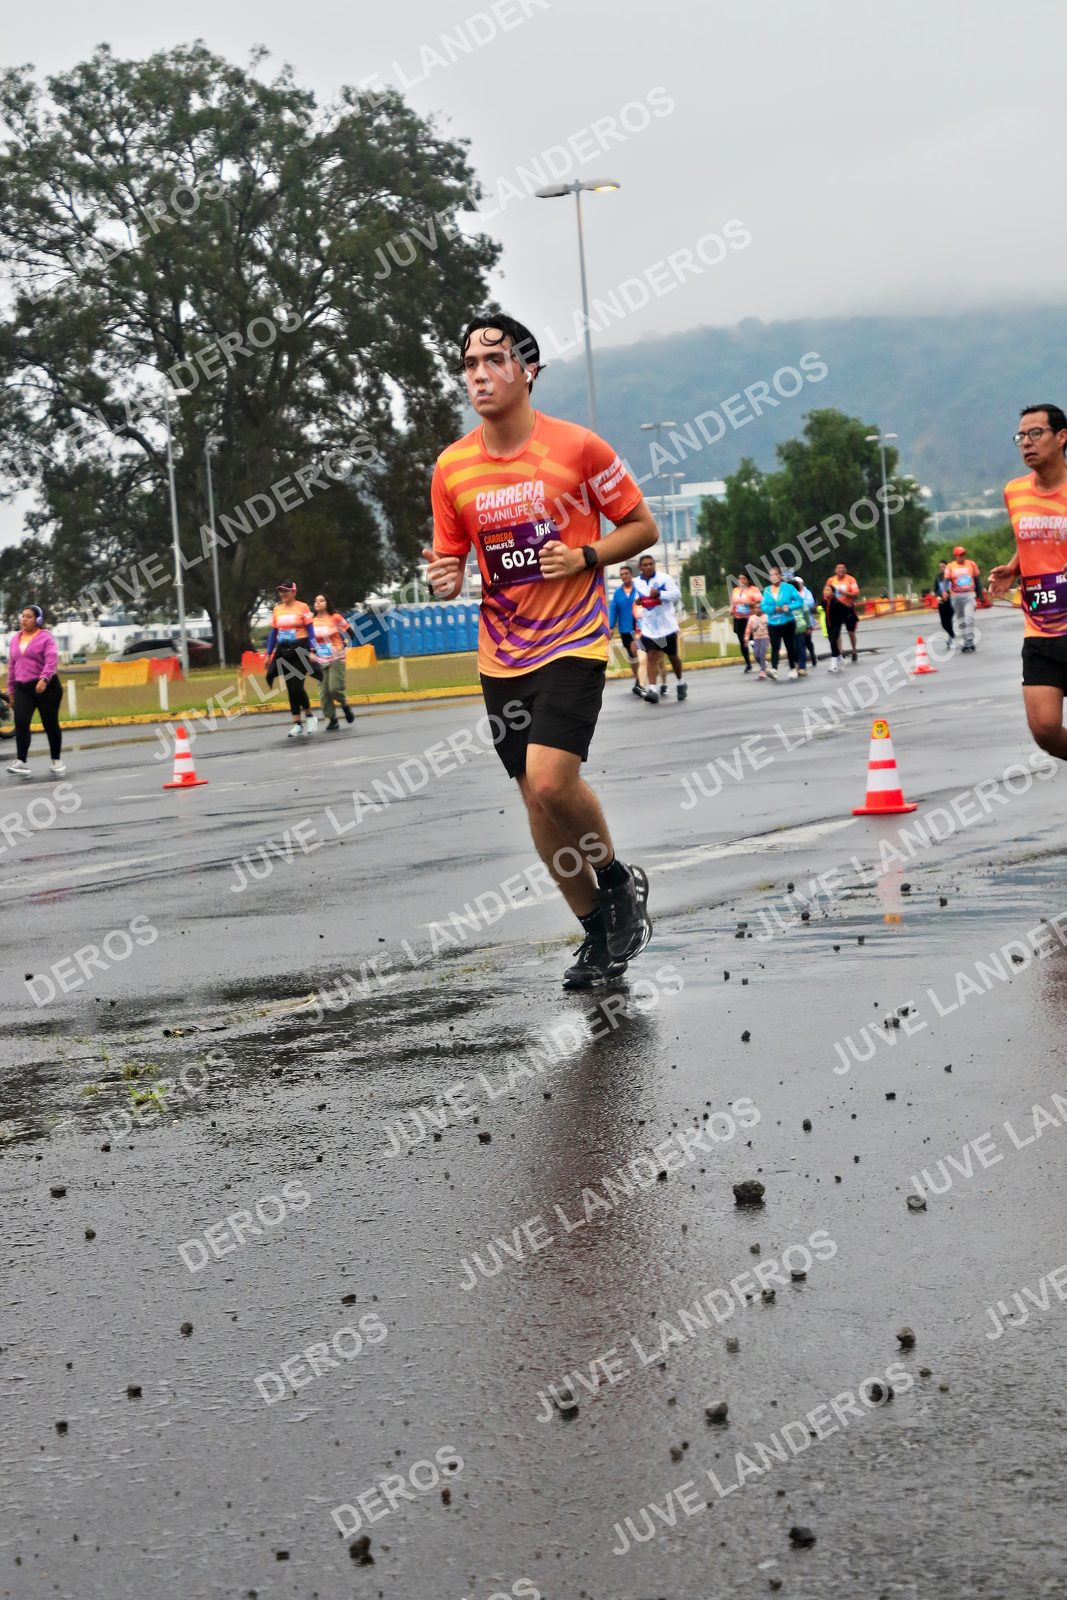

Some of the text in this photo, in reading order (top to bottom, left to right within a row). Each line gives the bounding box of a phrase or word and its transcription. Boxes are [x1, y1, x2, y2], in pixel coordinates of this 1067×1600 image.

[475, 479, 545, 512] CARRERA
[478, 502, 529, 525] OMNILIFE
[483, 531, 513, 545] CARRERA
[501, 547, 538, 570] 602
[1034, 590, 1057, 605] 735
